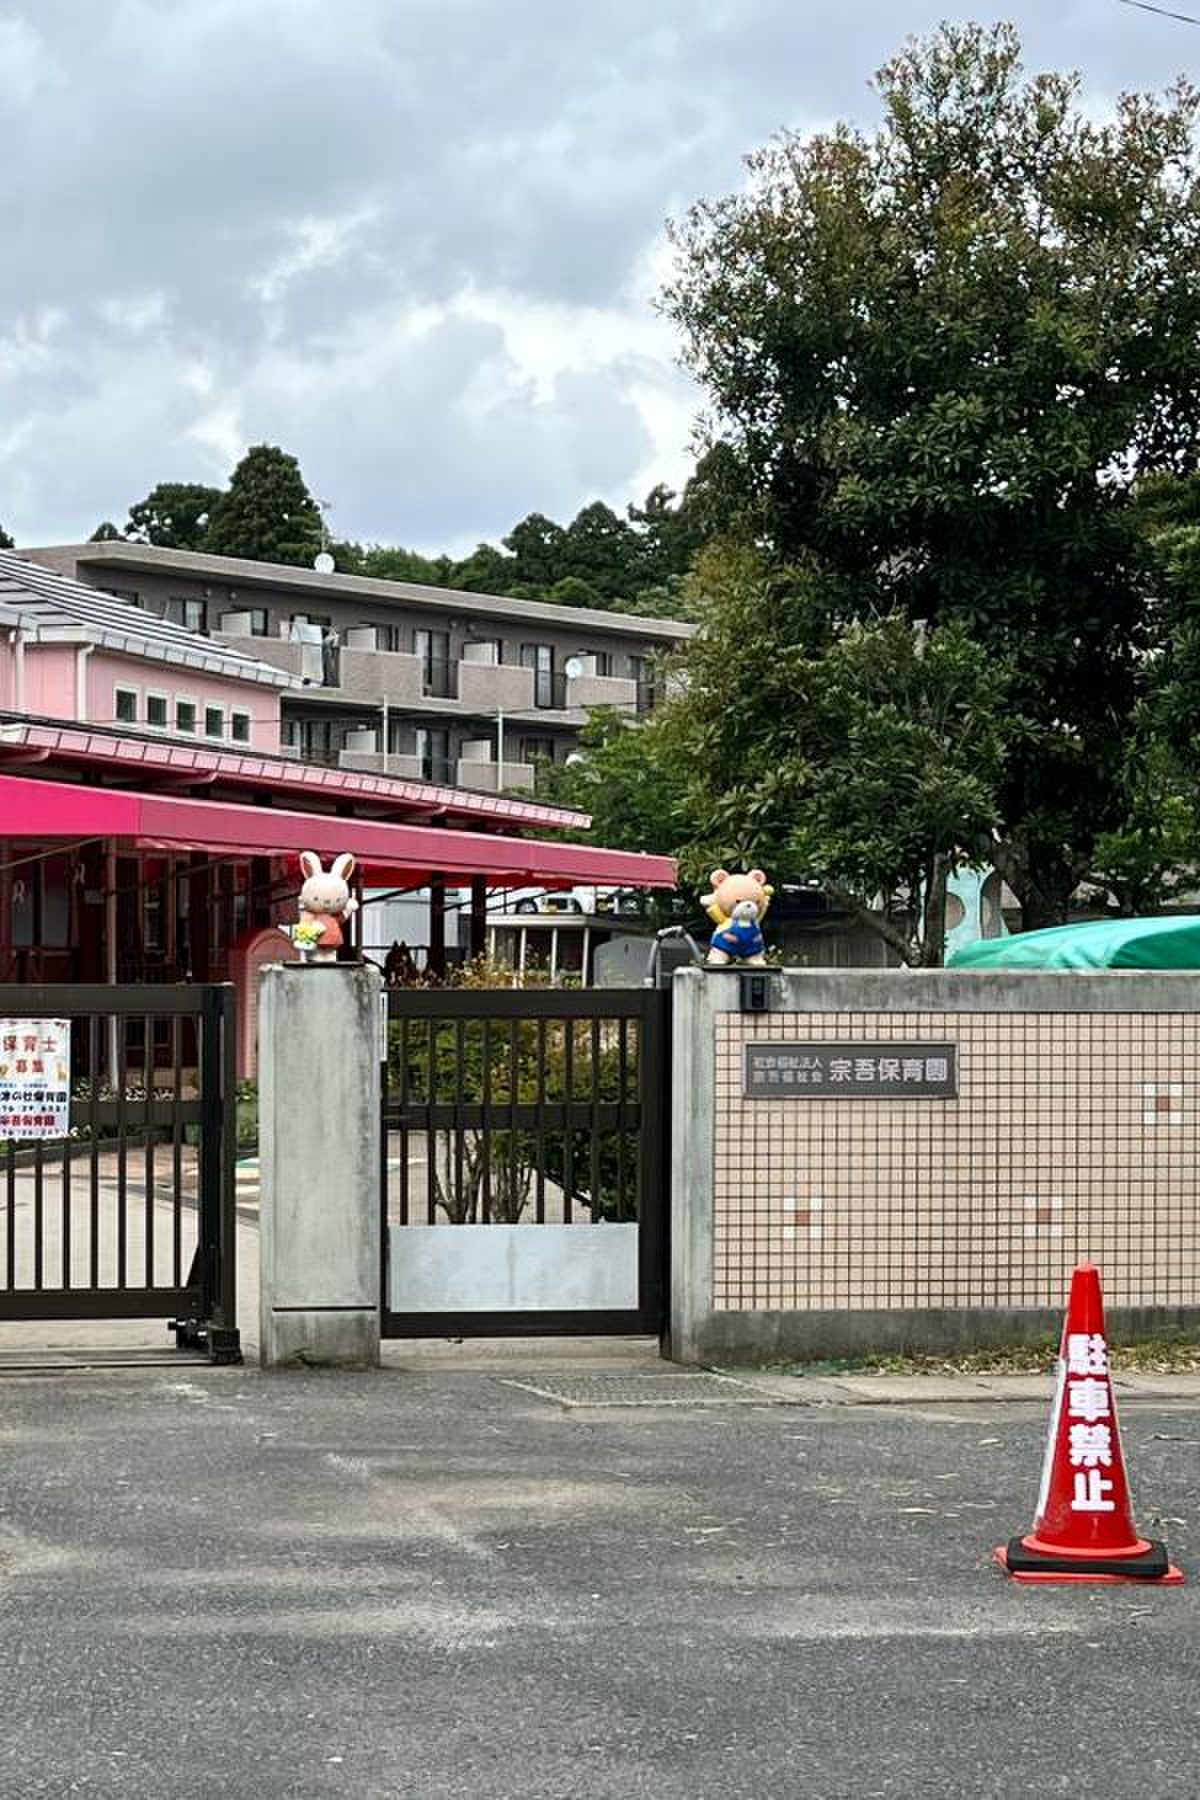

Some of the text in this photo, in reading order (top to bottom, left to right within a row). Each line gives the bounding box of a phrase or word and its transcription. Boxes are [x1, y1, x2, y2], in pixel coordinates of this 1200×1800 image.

[3, 1035, 57, 1052] 保育士
[829, 1057, 948, 1082] 宗吾保育園
[1067, 1333, 1115, 1512] 駐車禁止
